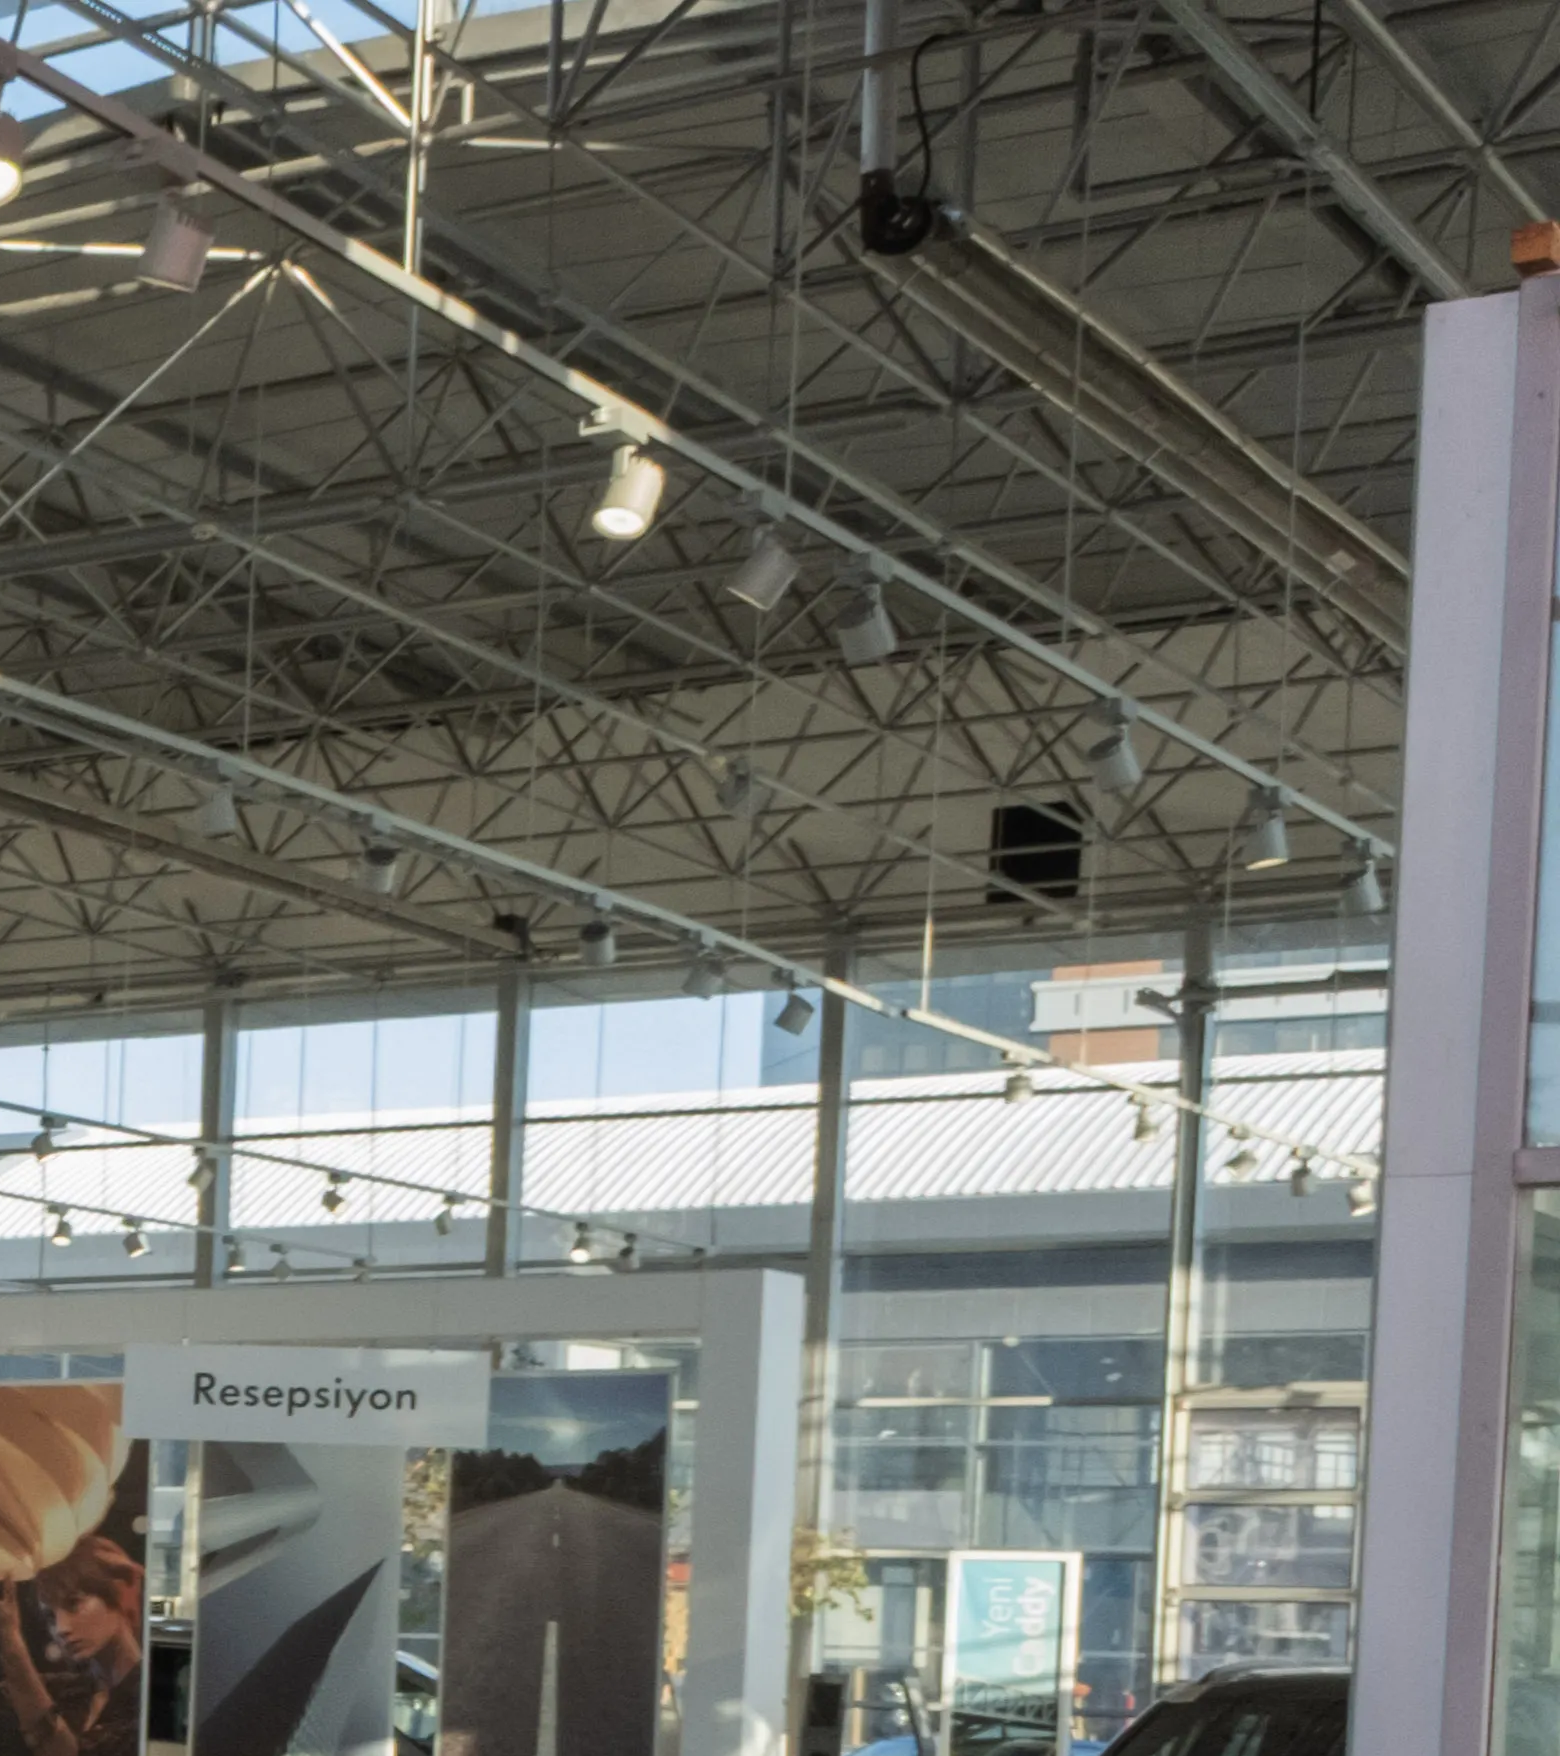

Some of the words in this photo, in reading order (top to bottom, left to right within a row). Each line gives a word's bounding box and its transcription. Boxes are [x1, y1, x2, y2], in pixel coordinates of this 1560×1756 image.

[192, 1372, 417, 1418] Resepsiyon
[980, 1577, 1014, 1639] Yeni
[1012, 1576, 1055, 1677] Caddy
